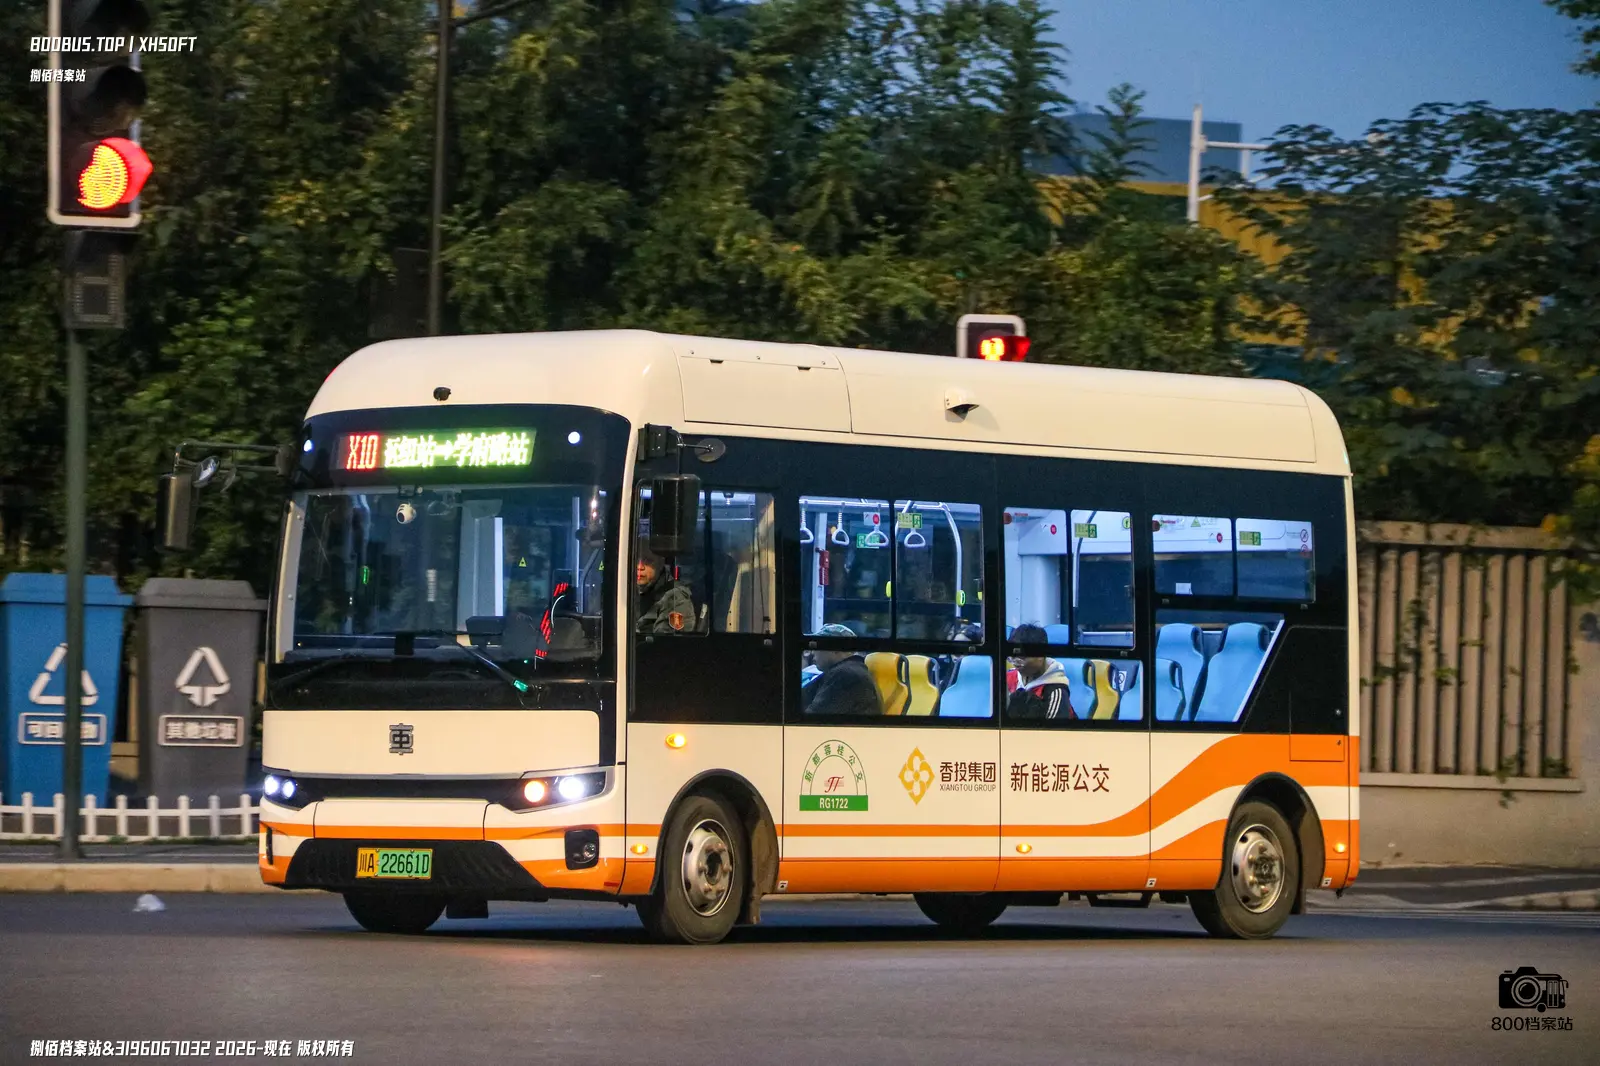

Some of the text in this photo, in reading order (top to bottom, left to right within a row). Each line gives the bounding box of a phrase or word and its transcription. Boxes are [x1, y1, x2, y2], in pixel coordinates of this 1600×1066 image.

[346, 433, 380, 470] X10
[939, 761, 996, 783] 香投集团
[1010, 762, 1110, 793] 新能源公交
[939, 783, 996, 792] XIANGTOU GROUP
[819, 797, 849, 809] RG1722
